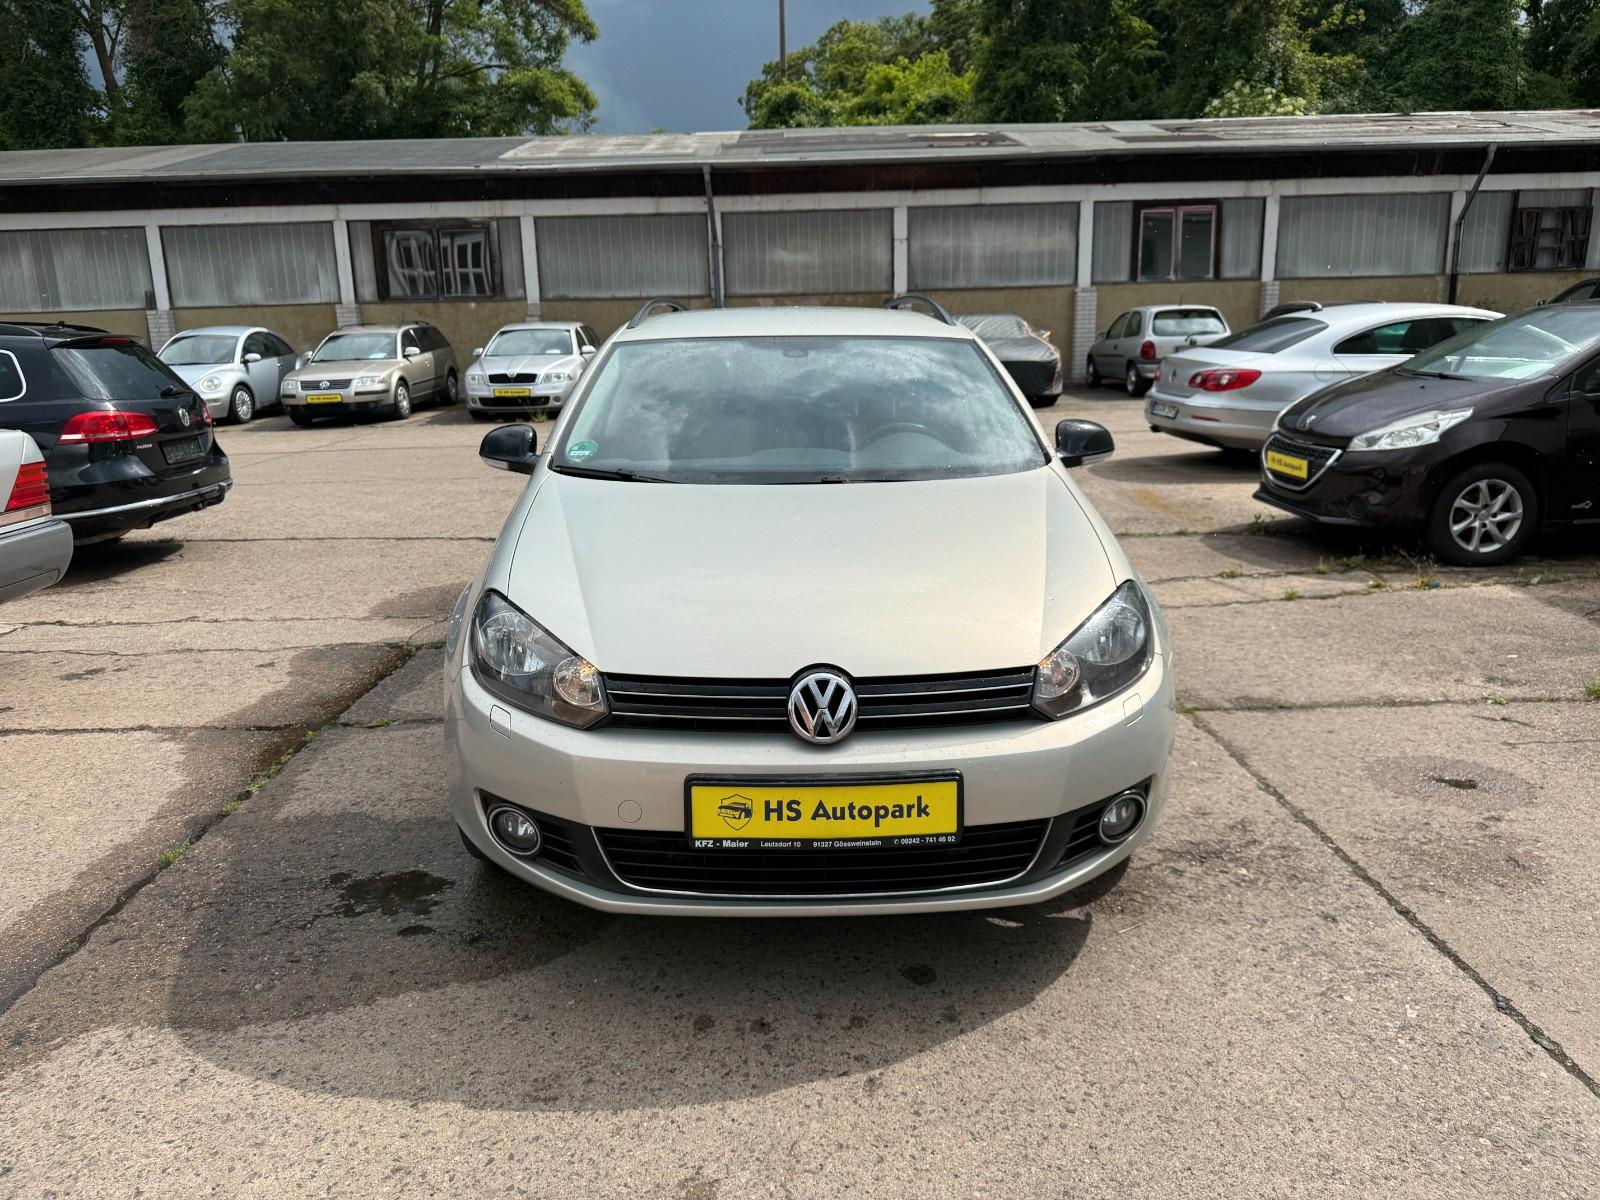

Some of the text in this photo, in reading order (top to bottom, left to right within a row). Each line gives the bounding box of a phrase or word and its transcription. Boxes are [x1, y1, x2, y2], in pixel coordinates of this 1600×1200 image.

[787, 672, 858, 745] VW
[764, 795, 931, 828] HS Autopark
[694, 839, 714, 848] KFZ
[722, 839, 749, 848] Maier
[900, 837, 920, 845] 09242
